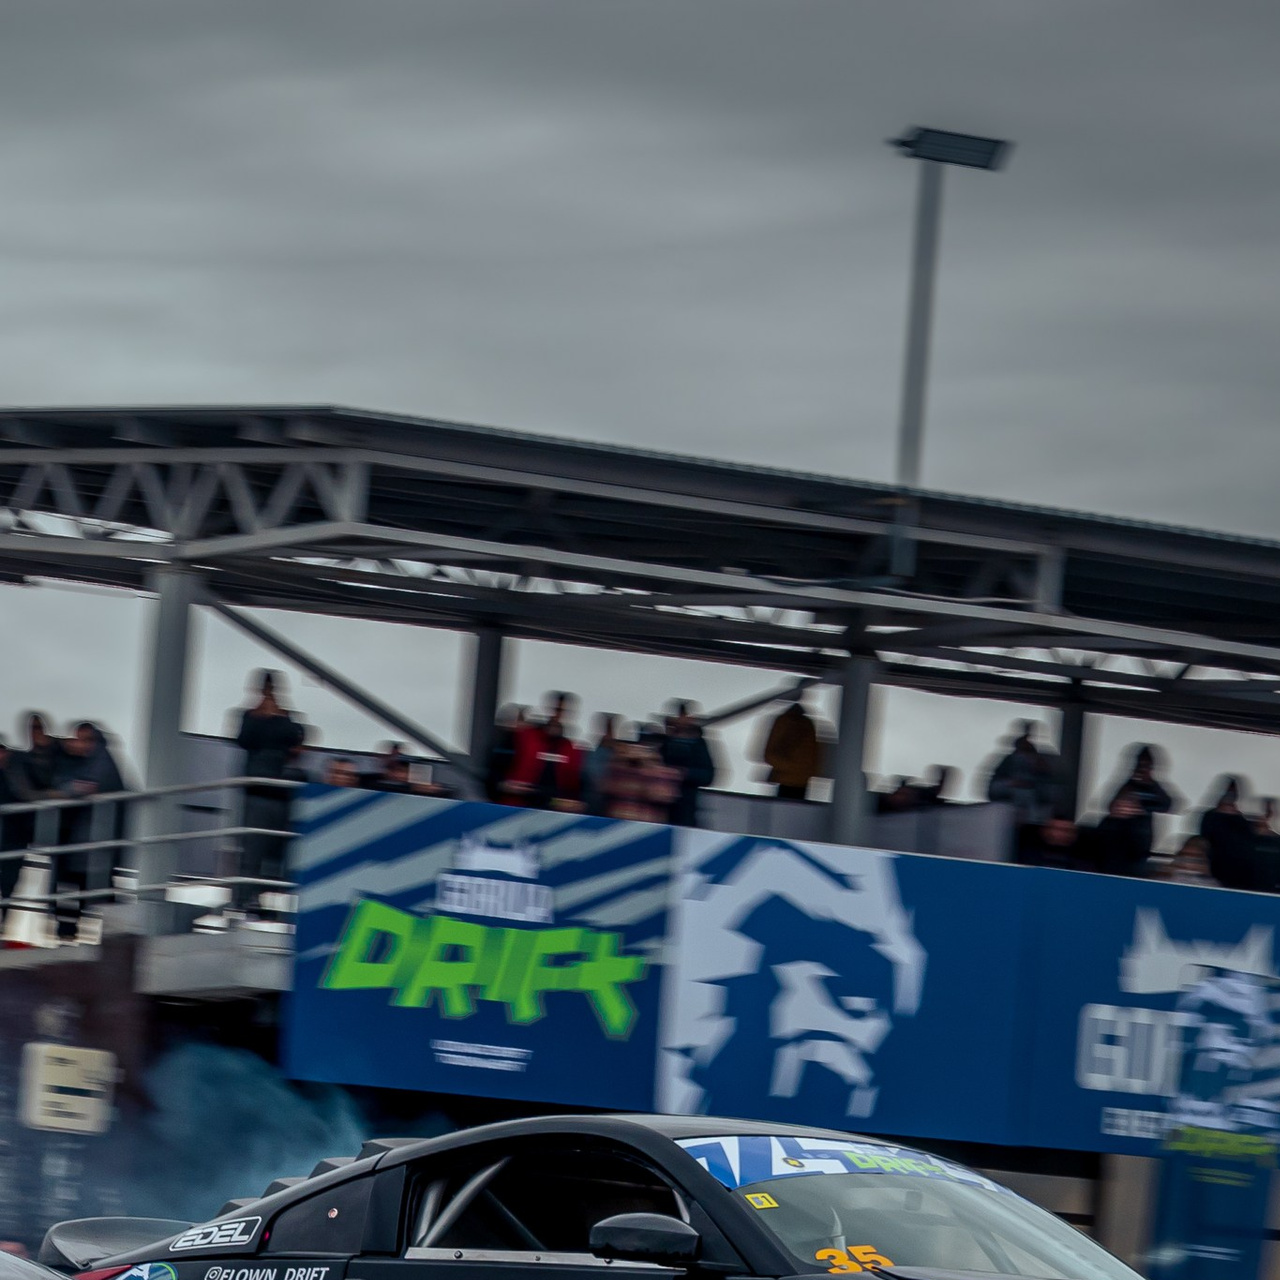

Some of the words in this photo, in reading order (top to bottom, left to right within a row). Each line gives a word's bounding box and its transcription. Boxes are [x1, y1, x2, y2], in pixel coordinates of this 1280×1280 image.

[320, 898, 646, 1040] DRIFT
[174, 1222, 251, 1249] EDEL
[815, 1245, 895, 1274] 35
